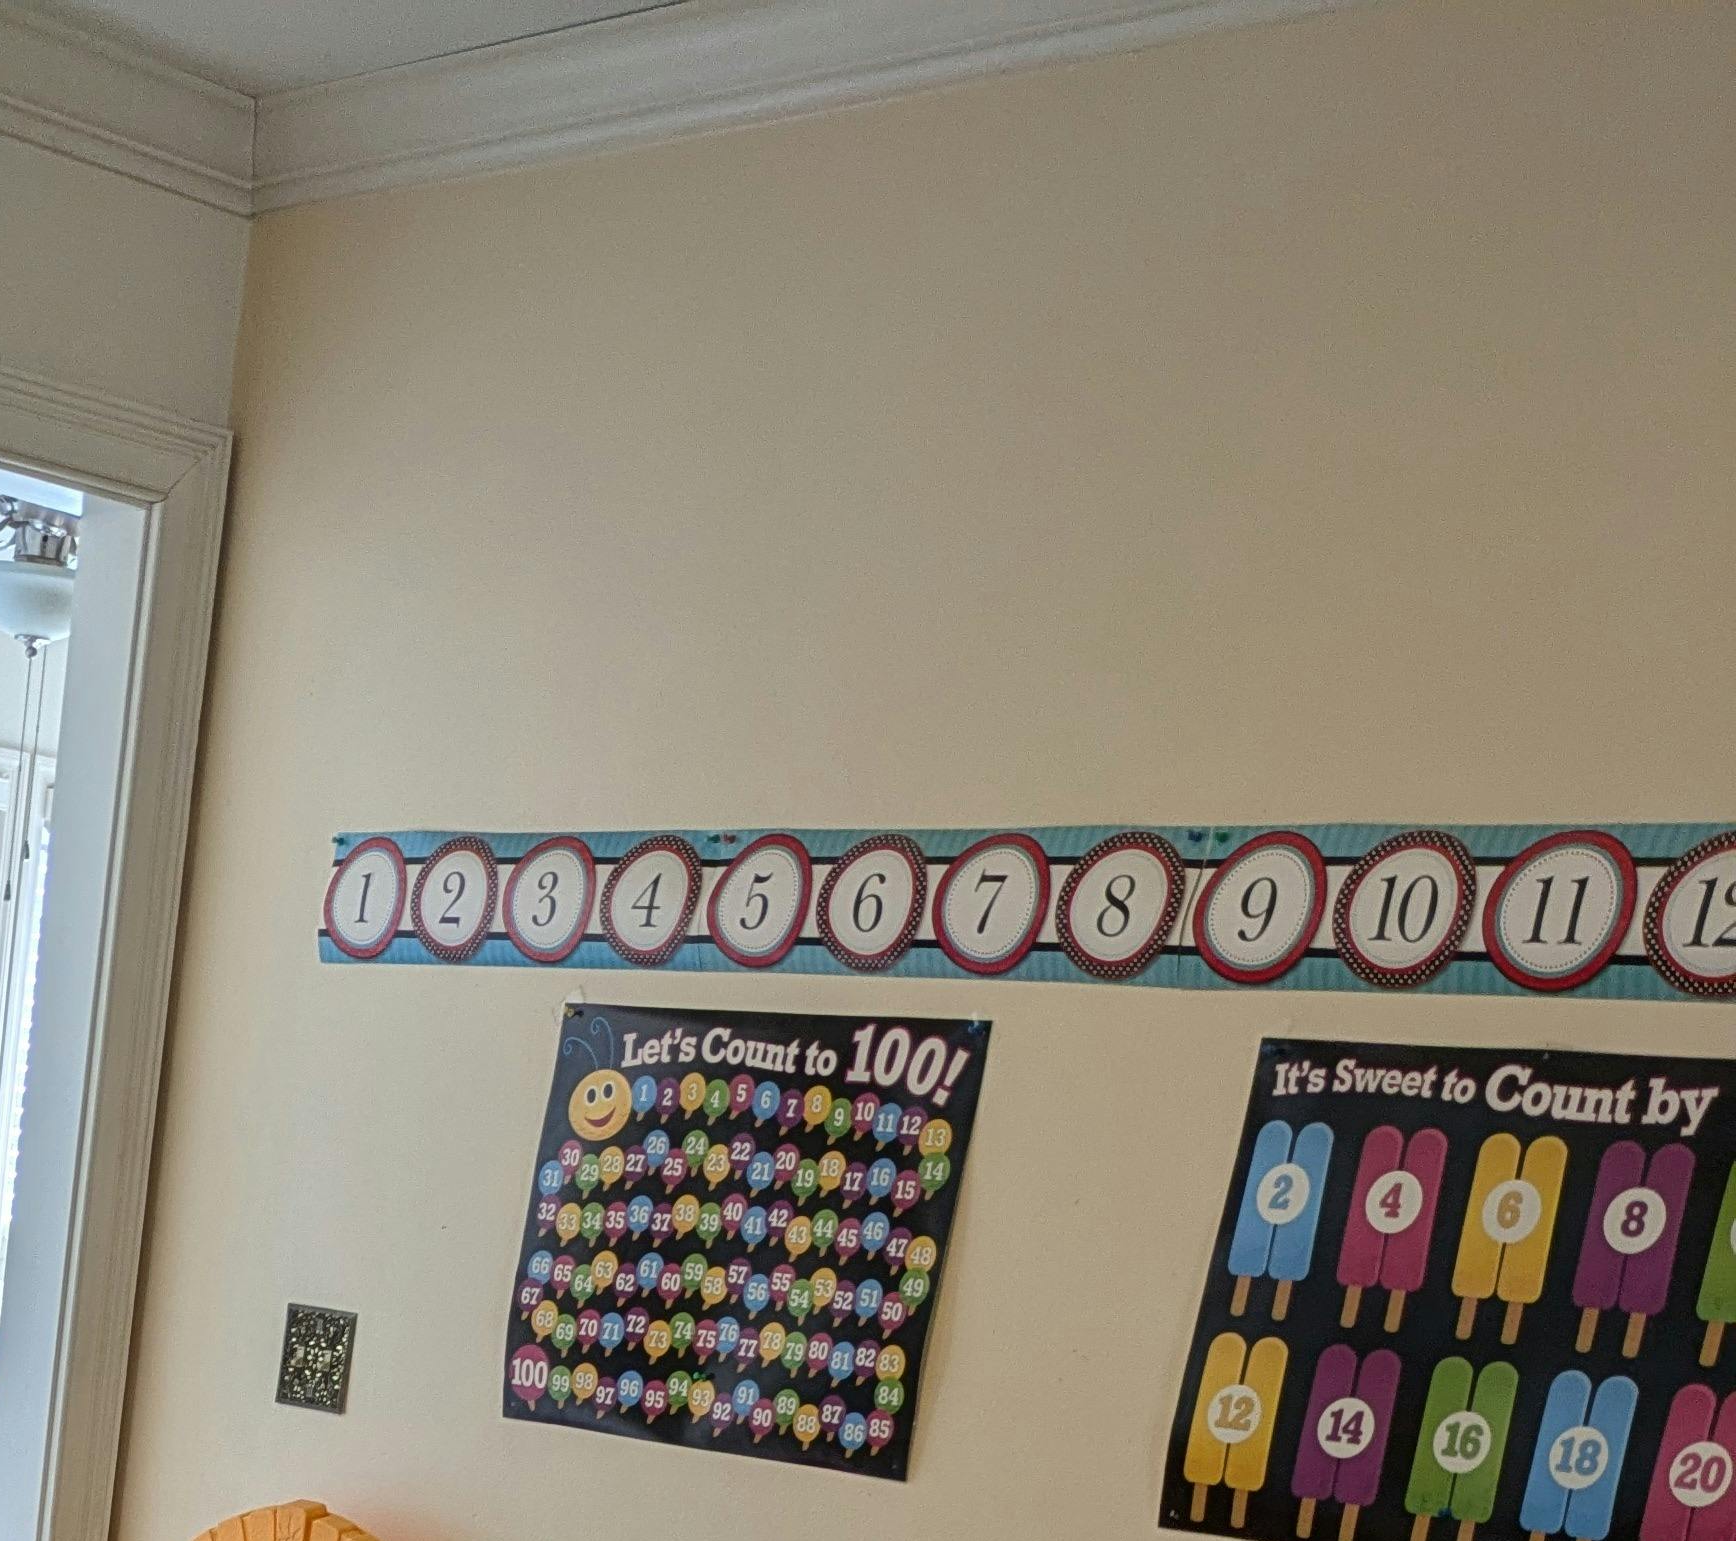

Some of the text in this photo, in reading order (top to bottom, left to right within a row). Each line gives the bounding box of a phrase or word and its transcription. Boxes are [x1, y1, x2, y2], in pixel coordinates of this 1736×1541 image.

[353, 872, 370, 925] 1
[439, 871, 466, 928] 2
[532, 871, 558, 928] 3
[631, 872, 661, 928] 4
[741, 873, 773, 931] 5
[852, 873, 885, 933] 6
[971, 874, 1007, 935] 7
[1096, 875, 1136, 937] 8
[1238, 877, 1278, 942] 9
[1368, 874, 1437, 942] 10
[1521, 874, 1587, 946] 11
[621, 1022, 971, 1107] Let's Count to 100!
[1272, 1057, 1720, 1137] It's Sweet to Count by
[639, 1083, 946, 1146] 1 2 3 4 5 6 7 8 9 10 11 12 13
[1269, 1173, 1651, 1239] 2 4 6 8
[511, 1357, 890, 1442] 100 99 98 97 96 95 94 93 92 91 90 89 88 87 86 85
[878, 1386, 899, 1406] 84
[1214, 1394, 1726, 1491] 12 14 16 18 20
